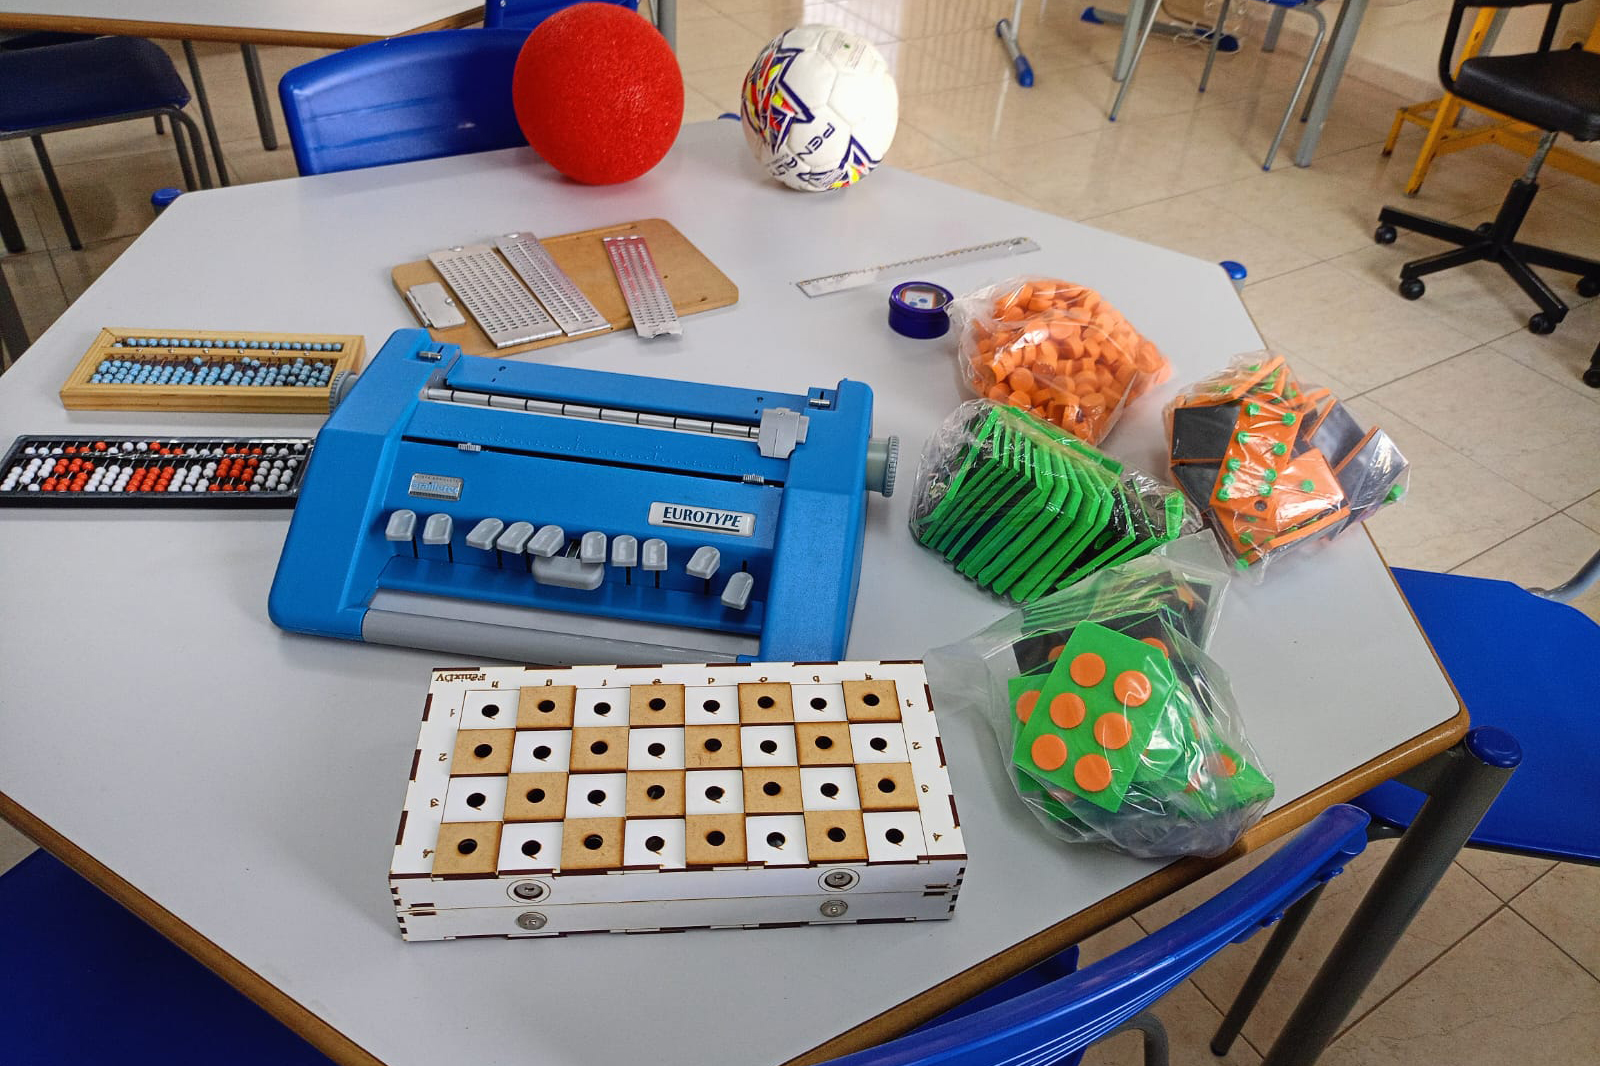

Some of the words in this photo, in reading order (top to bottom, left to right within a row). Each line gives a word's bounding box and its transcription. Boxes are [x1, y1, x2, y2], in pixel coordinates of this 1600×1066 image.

[663, 506, 743, 528] EUROTYPE
[707, 677, 716, 685] d
[812, 675, 820, 683] b
[906, 699, 913, 707] 1
[449, 708, 455, 717] 1
[911, 741, 922, 750] 2
[438, 752, 448, 761] 2
[920, 784, 929, 793] 3
[430, 797, 439, 808] 3
[932, 832, 943, 842] 4
[422, 848, 434, 859] 4
